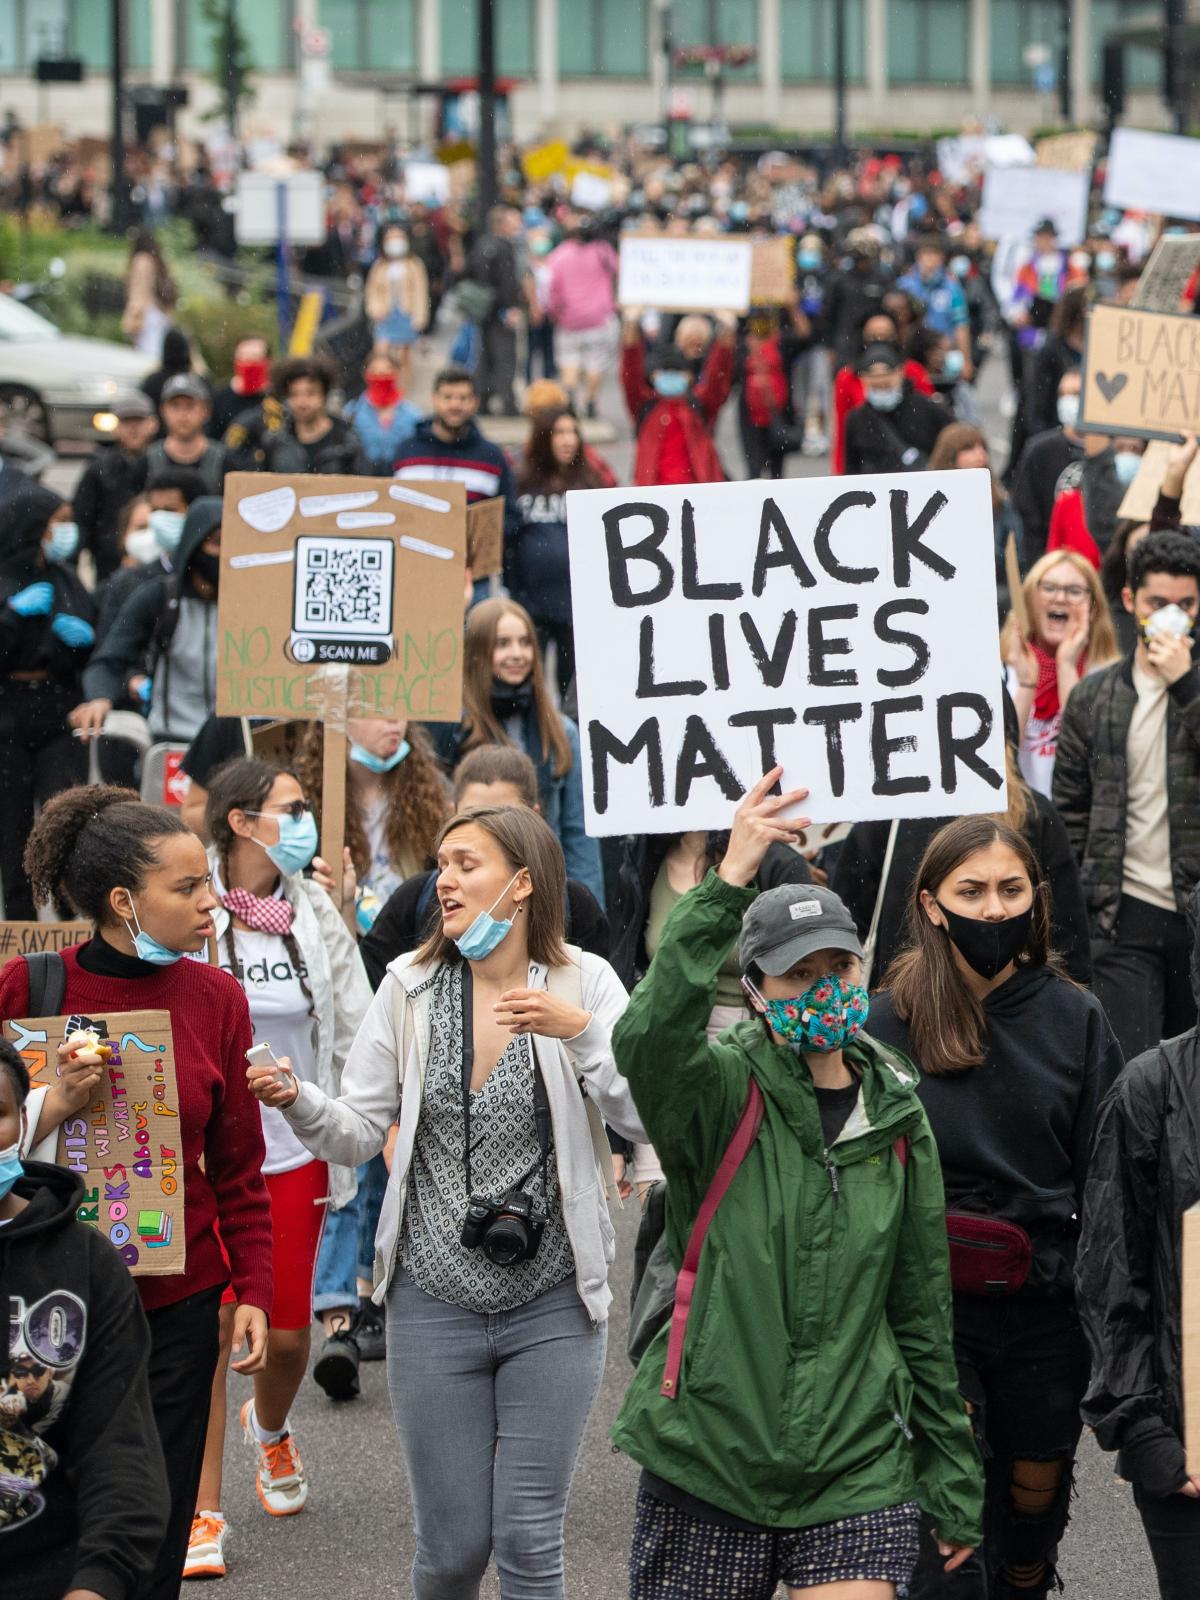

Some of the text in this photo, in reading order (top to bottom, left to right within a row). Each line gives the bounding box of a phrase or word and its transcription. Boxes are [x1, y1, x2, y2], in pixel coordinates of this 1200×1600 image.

[602, 489, 957, 608] BLACK
[223, 626, 270, 669] NO
[318, 640, 378, 661] SCAN ME
[403, 627, 459, 673] NO
[635, 597, 932, 699] LIVES
[222, 670, 318, 713] JUSTICE
[587, 691, 1004, 815] MATTER
[219, 957, 309, 983] idas
[106, 1039, 131, 1142] WRITTEN
[90, 1100, 139, 1267] BOOKS WILL
[508, 1205, 525, 1213] SONY
